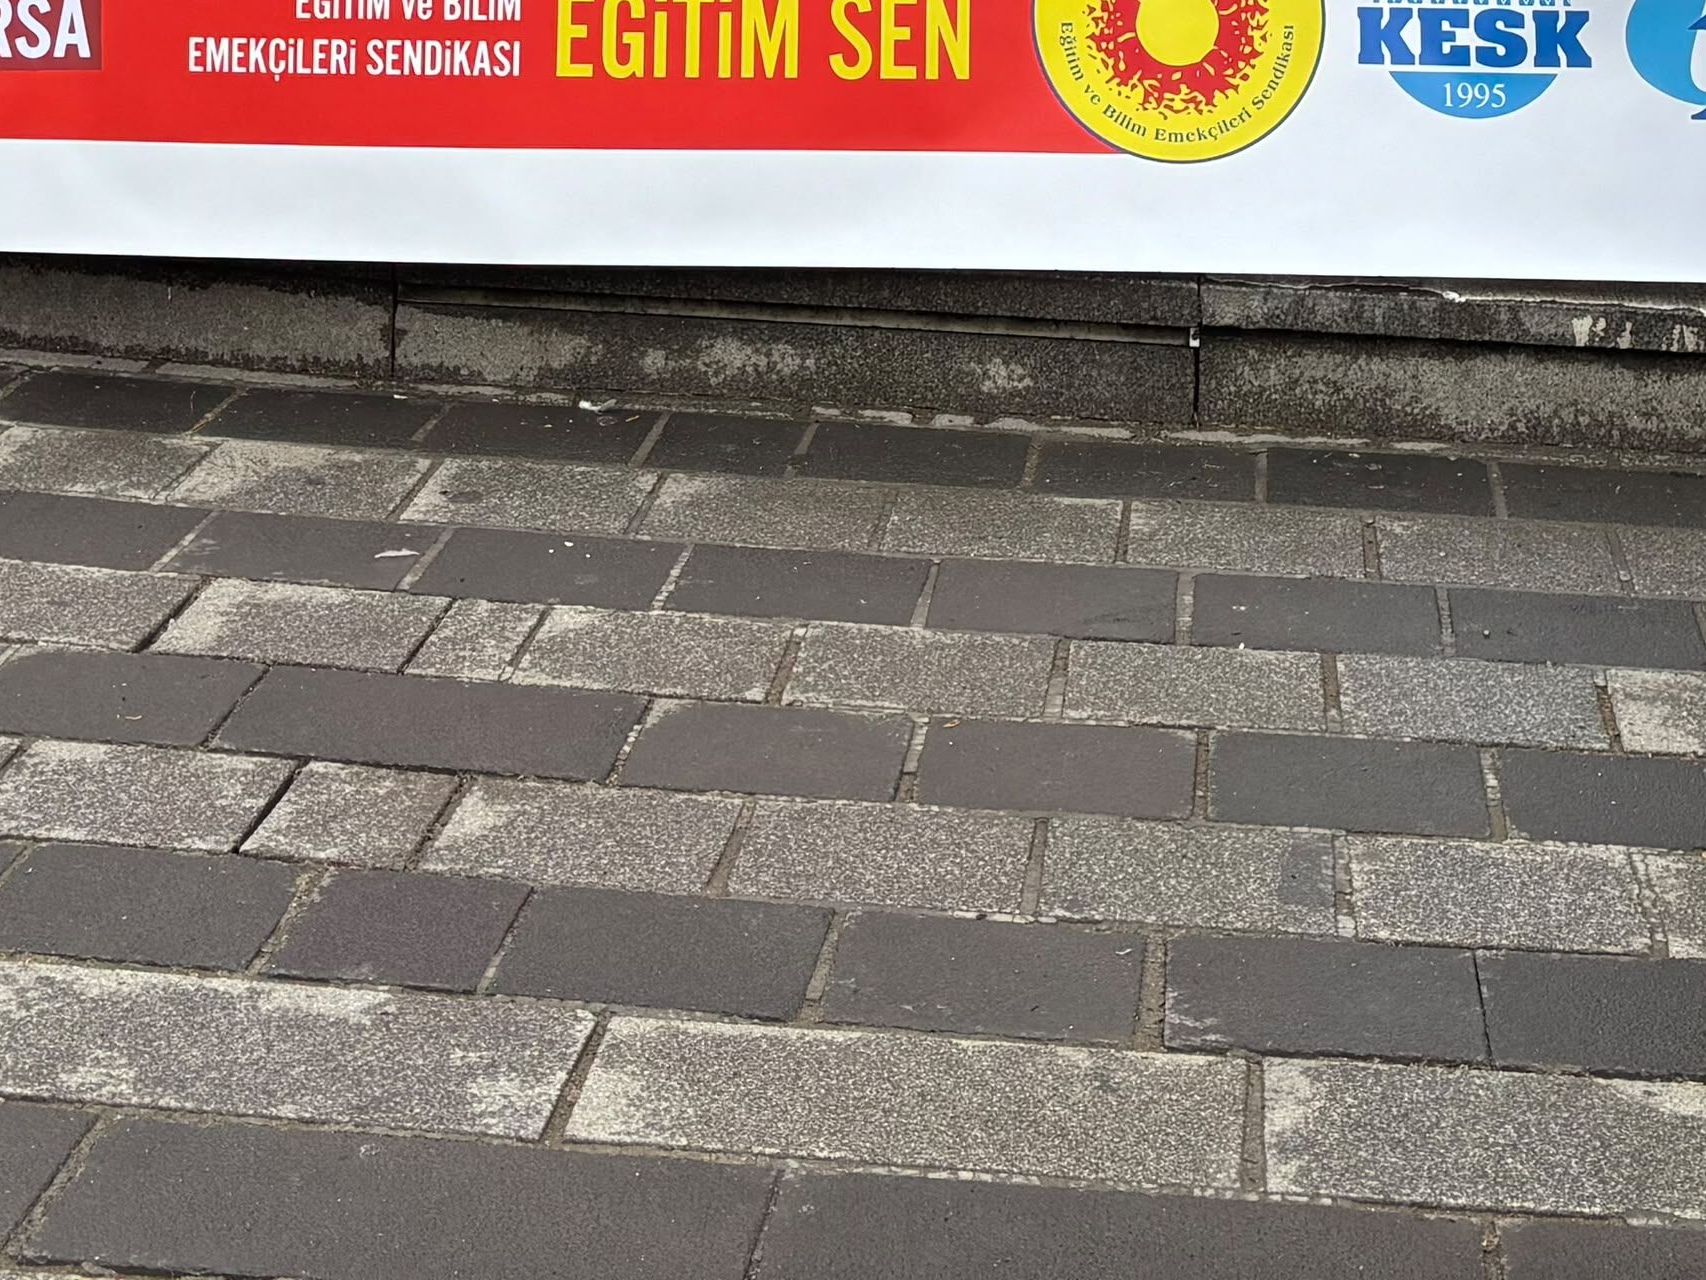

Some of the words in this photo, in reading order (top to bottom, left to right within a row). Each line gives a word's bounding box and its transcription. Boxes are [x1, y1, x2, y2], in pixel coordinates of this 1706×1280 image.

[1357, 6, 1592, 68] KESK
[1059, 22, 1084, 81] Eğitim
[1084, 84, 1101, 106] ve
[1102, 104, 1147, 137] Bilim
[1153, 107, 1250, 143] Emekçileri
[1253, 24, 1295, 111] Sendikası
[1443, 82, 1507, 109] 1995
